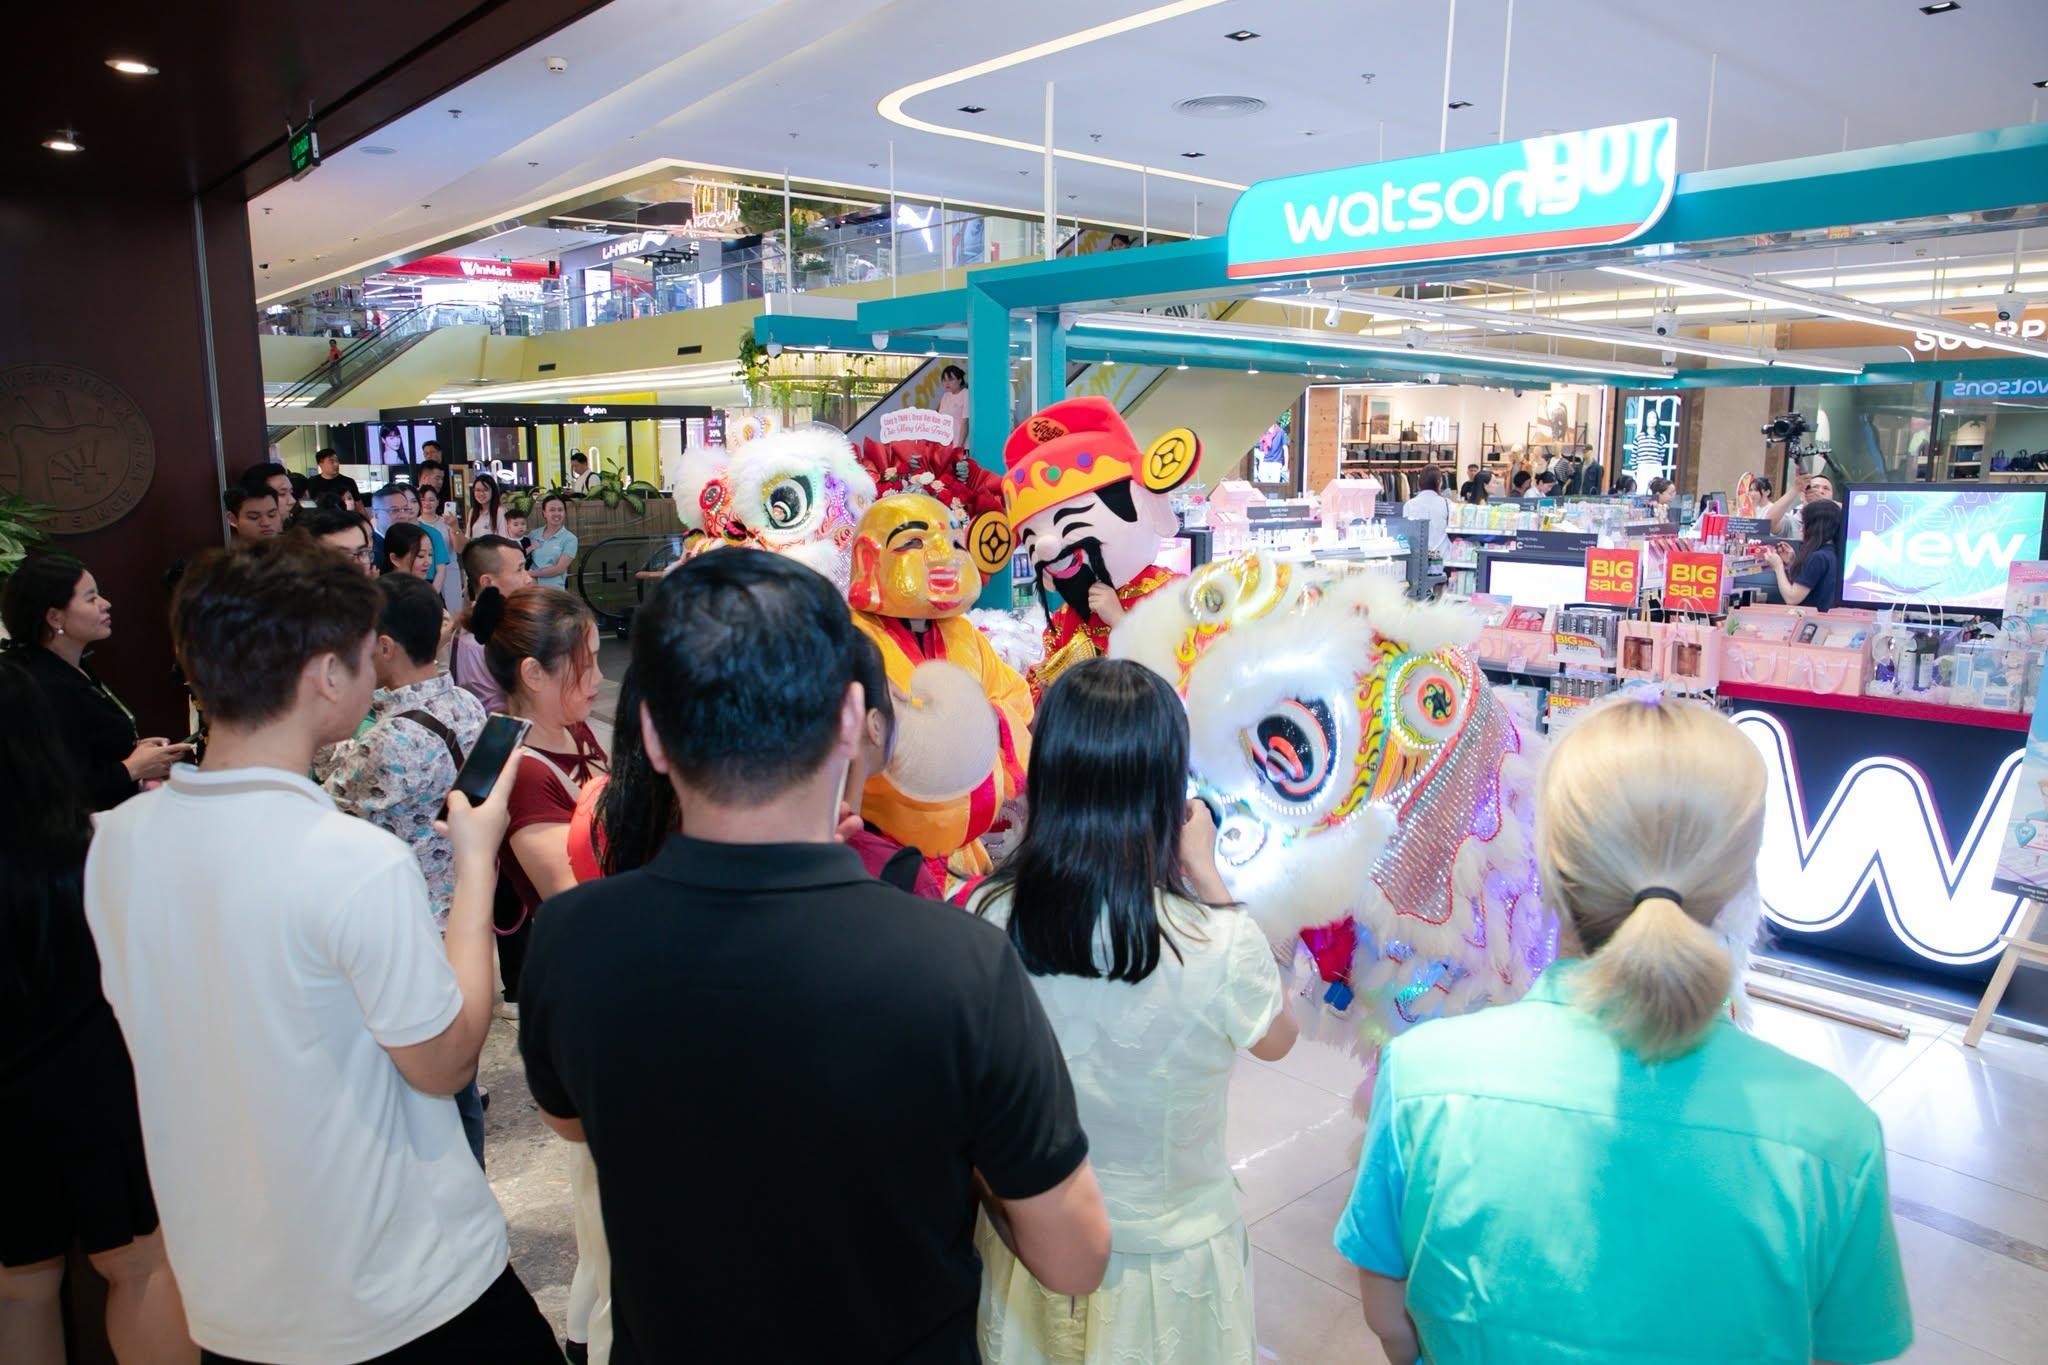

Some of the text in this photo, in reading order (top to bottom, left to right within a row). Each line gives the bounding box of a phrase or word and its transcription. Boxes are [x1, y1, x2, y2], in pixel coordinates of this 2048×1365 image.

[460, 261, 512, 277] WinMart
[584, 405, 607, 416] dyson
[601, 560, 628, 584] L1
[1591, 560, 1634, 579] BIG
[1671, 563, 1717, 584] BIG
[1556, 633, 1578, 645] BIG
[1549, 696, 1571, 707] BIG
